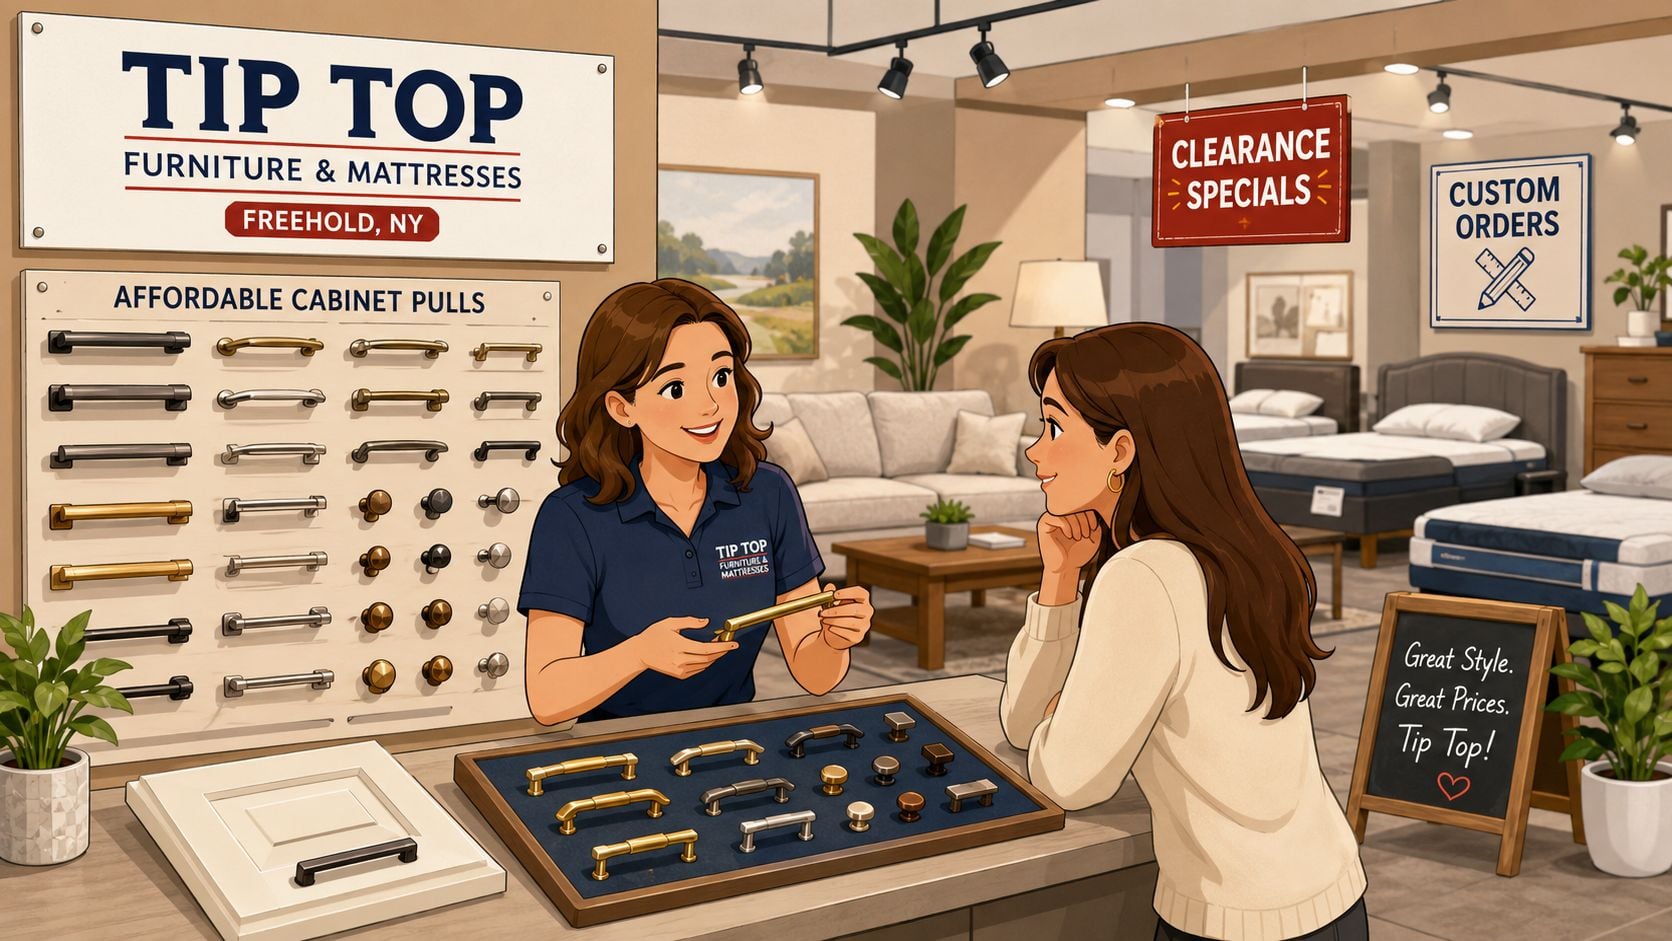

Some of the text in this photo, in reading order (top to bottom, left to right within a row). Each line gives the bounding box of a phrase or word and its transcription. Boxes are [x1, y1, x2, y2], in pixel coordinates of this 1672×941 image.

[122, 51, 524, 144] TIP TOP
[1171, 127, 1331, 170] CLEARANCE
[124, 152, 522, 189] FURNITURE & MATTRESSES
[1186, 174, 1312, 210] SPECIALS
[1449, 175, 1560, 208] CUSTOM
[243, 209, 424, 237] FREEHOLD, NY
[1455, 210, 1560, 240] ORDERS
[113, 285, 486, 314] AFFORDABLE CABINET PULLS
[715, 539, 768, 559] TIP TOP
[1404, 641, 1514, 682] Great Style.
[1395, 682, 1510, 715] Great Prices.
[1398, 723, 1497, 769] Tip Top!
